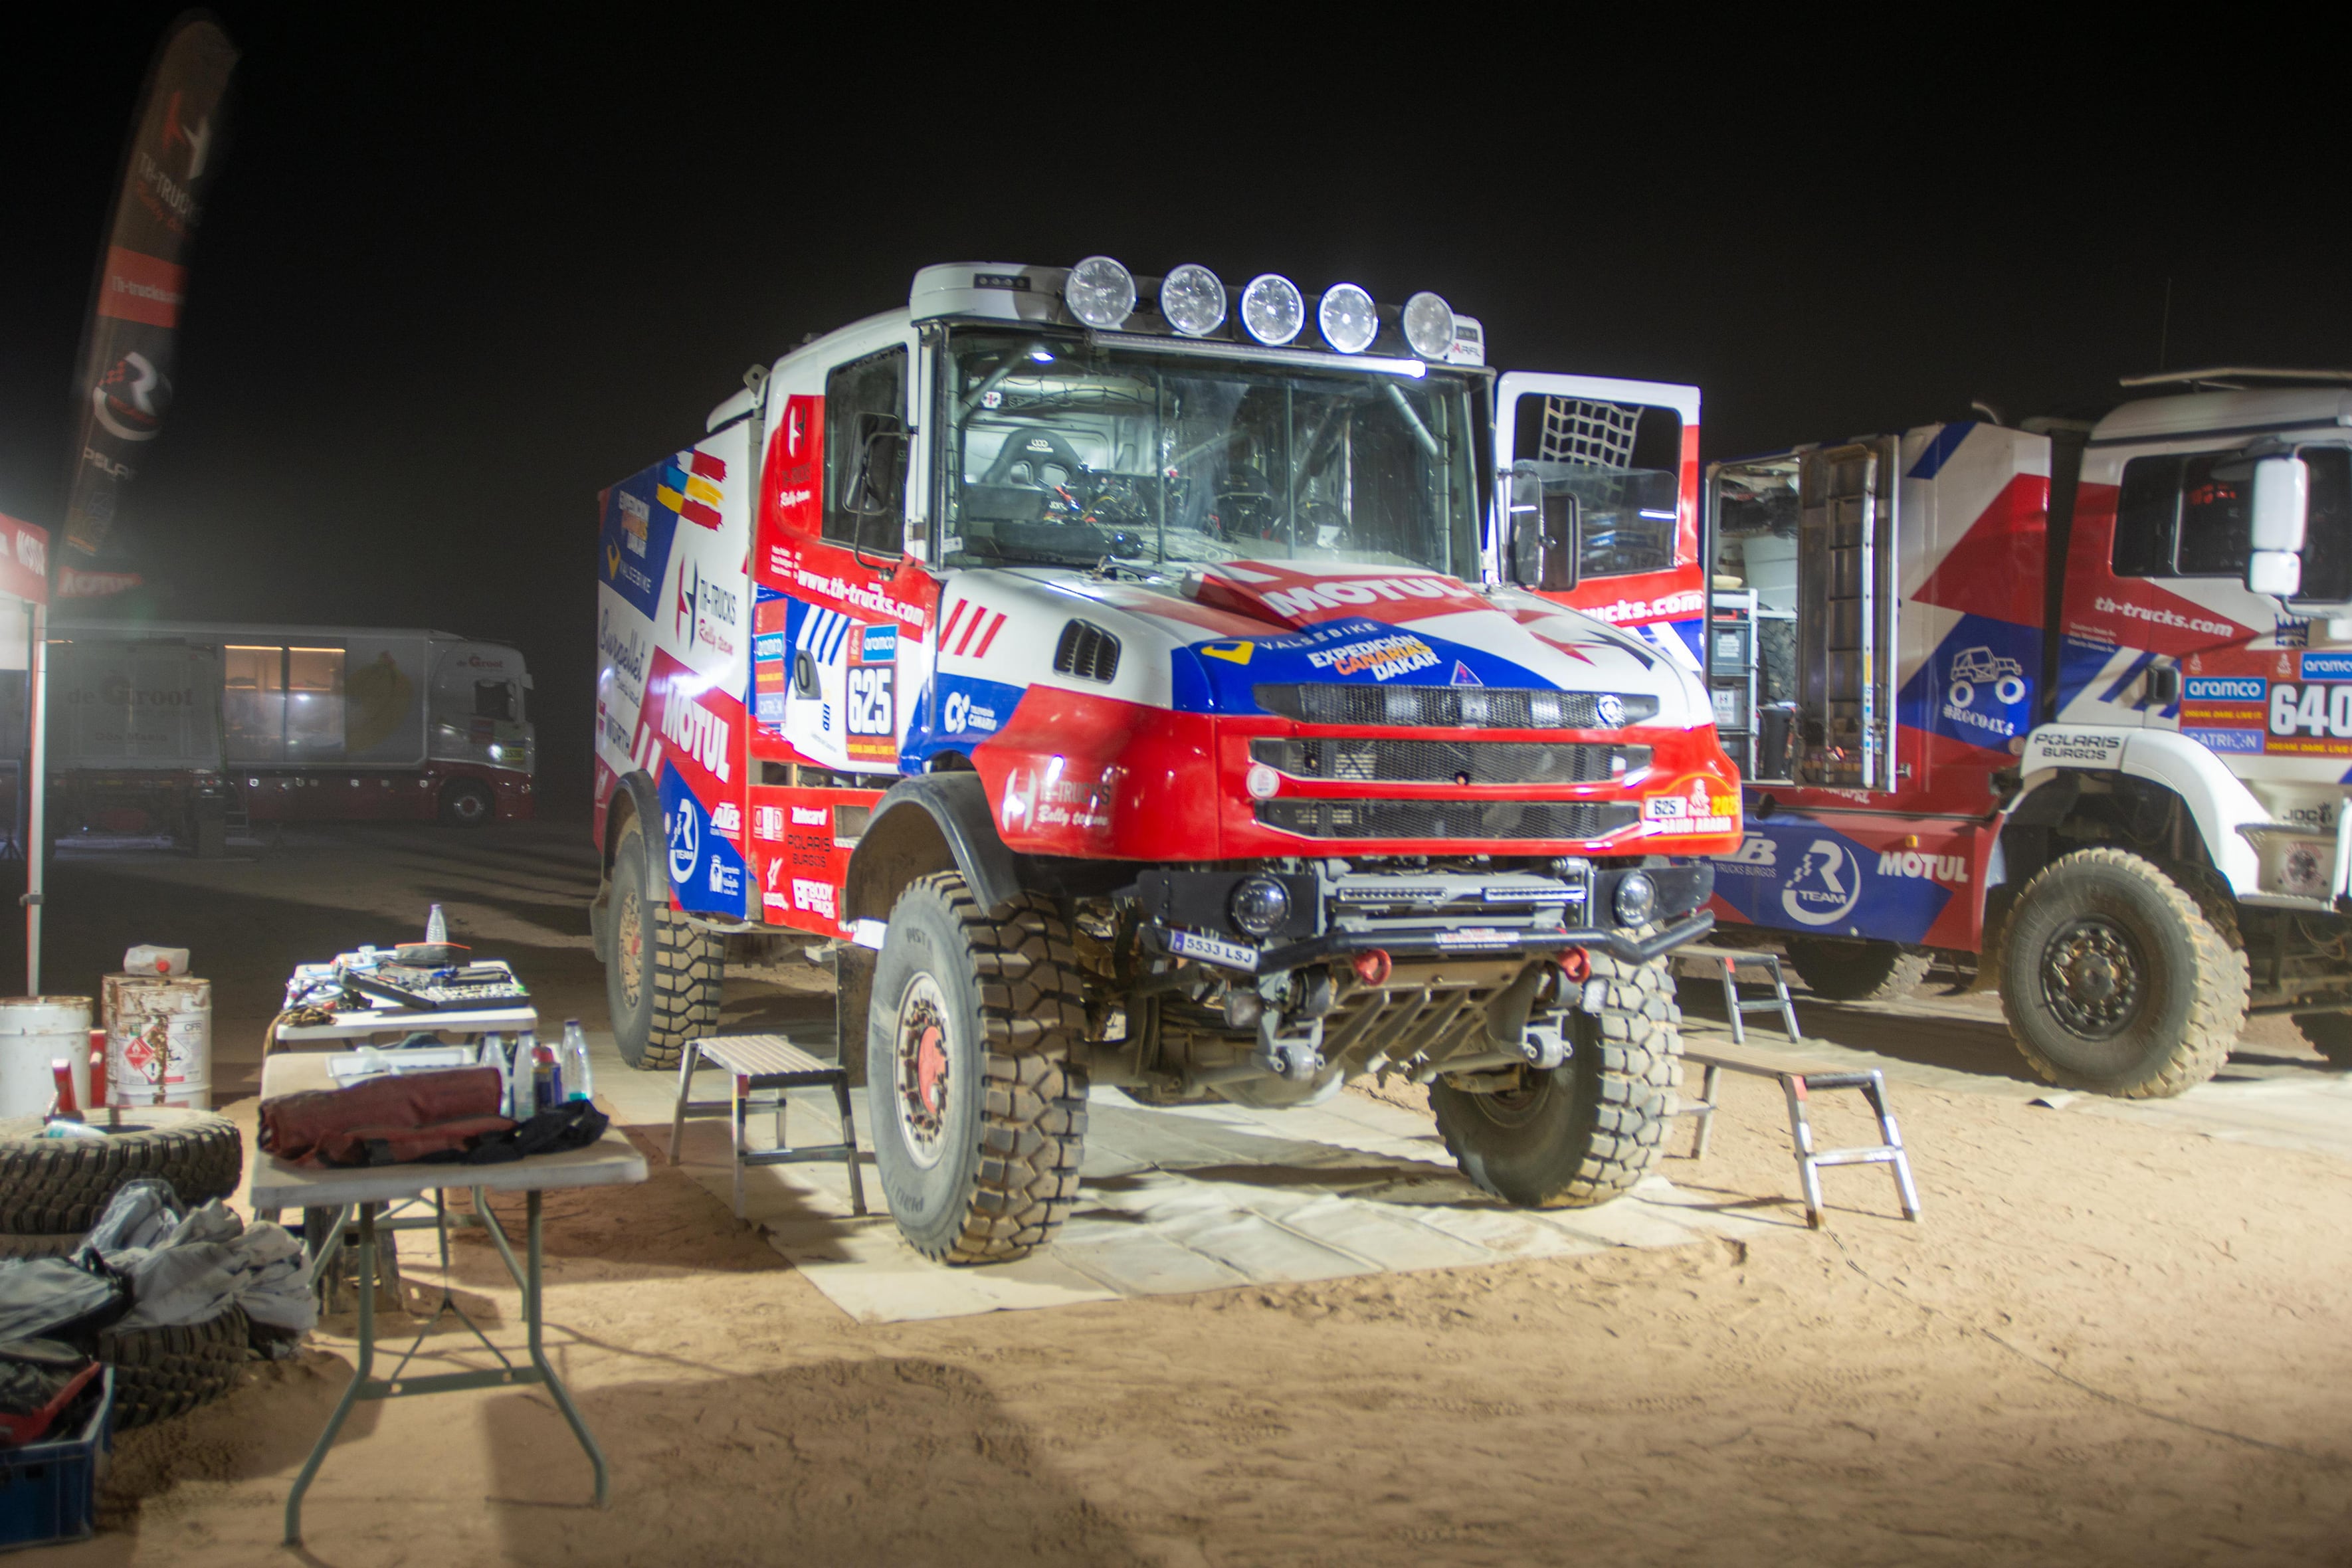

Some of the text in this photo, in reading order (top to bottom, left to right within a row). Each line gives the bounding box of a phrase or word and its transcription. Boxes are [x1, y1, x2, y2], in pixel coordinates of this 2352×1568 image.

[797, 569, 924, 627] www.th-trucks.com
[1262, 577, 1476, 618] MOTUL
[2095, 597, 2234, 638] th-trucks.com
[864, 636, 895, 650] aramco
[1262, 622, 1378, 650] VALSEBIKE
[1306, 633, 1419, 668] EXPEDICIÓN
[1335, 643, 1432, 676] CANARIAS
[1371, 652, 1442, 682] DAKAR
[2304, 659, 2352, 672] aramc
[848, 668, 892, 734] 625
[2189, 681, 2262, 697] aramco
[2270, 684, 2352, 738] 640
[661, 683, 730, 784] MOTUL
[2034, 733, 2121, 749] POLARIS
[2042, 747, 2107, 761] BURGOS
[710, 802, 741, 831] ATB
[1037, 805, 1070, 827] Rally
[1654, 800, 1676, 815] 625
[1695, 817, 1731, 832] ARABIA
[788, 834, 831, 852] POLARIS
[793, 853, 827, 868] BURGOS
[1717, 863, 1777, 878] TRUCKS BURGOS
[1878, 851, 1969, 883] MOTUL
[1799, 890, 1847, 904] TEAM
[1187, 937, 1221, 955] 5533
[1225, 947, 1252, 963] LSJ
